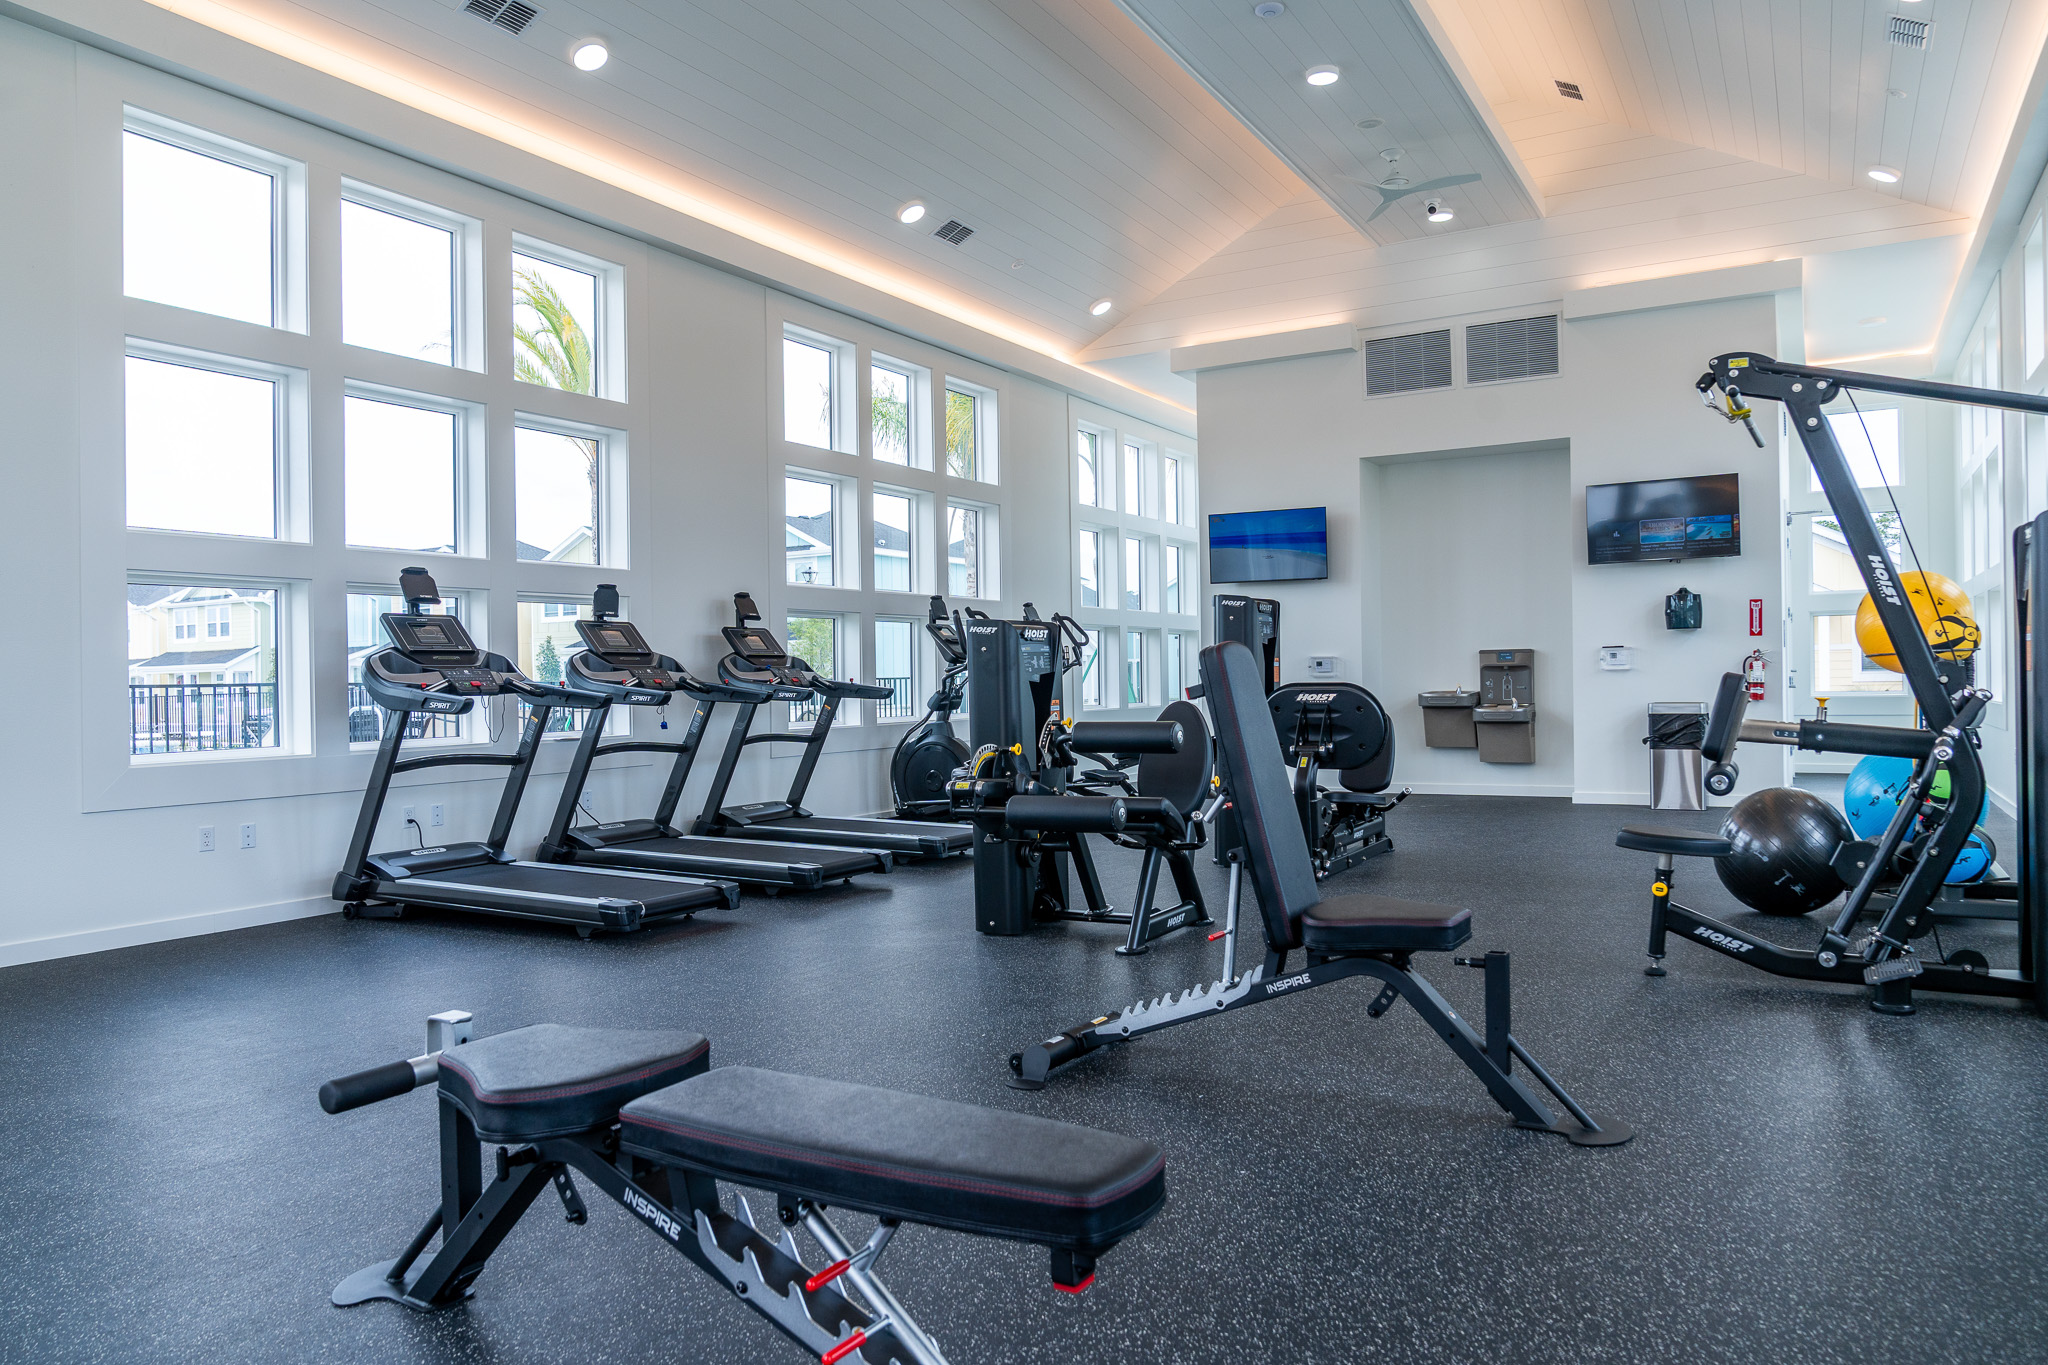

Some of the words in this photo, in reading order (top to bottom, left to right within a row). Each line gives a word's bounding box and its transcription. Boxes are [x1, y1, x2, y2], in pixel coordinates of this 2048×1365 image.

[1867, 554, 1902, 606] HOIST
[1221, 599, 1246, 607] HOIST
[969, 625, 998, 634] HOIST
[1024, 629, 1049, 638] HOIST
[1296, 693, 1337, 701] HOIST
[428, 701, 452, 710] SPIRIT
[1167, 912, 1186, 928] HOIST
[1693, 926, 1754, 952] HOIST
[1265, 973, 1312, 994] INSPIRE
[623, 1186, 682, 1241] INSPIRE
